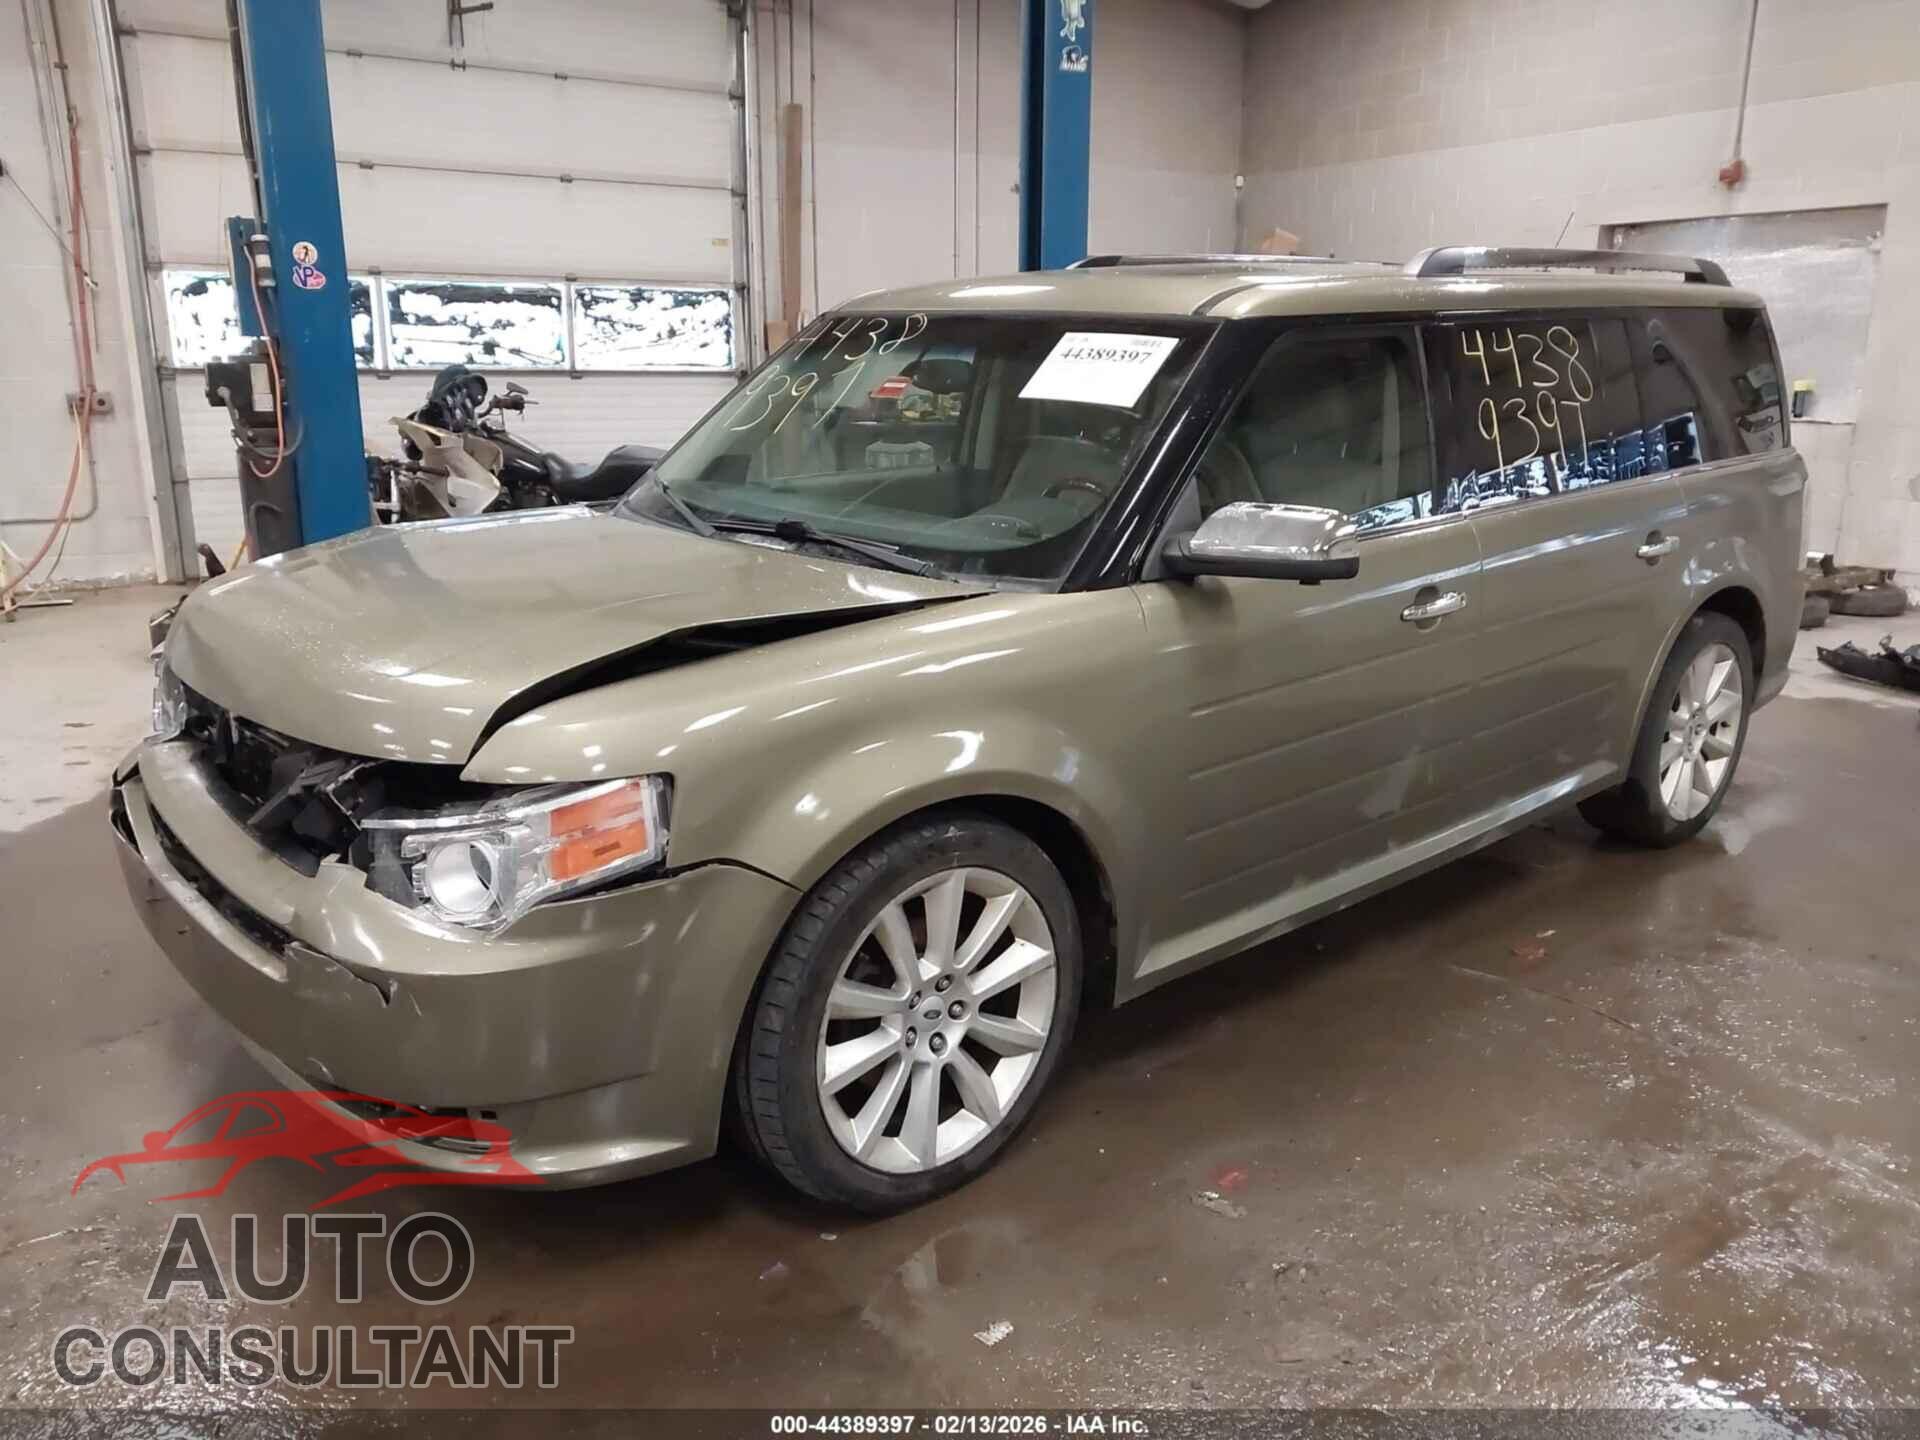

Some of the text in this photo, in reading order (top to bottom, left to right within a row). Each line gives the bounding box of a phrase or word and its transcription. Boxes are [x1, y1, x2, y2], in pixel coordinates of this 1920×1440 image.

[1060, 347, 1153, 363] 44389397
[1461, 325, 1594, 402] 4438
[723, 360, 866, 435] 9397
[1478, 390, 1590, 482] 9397
